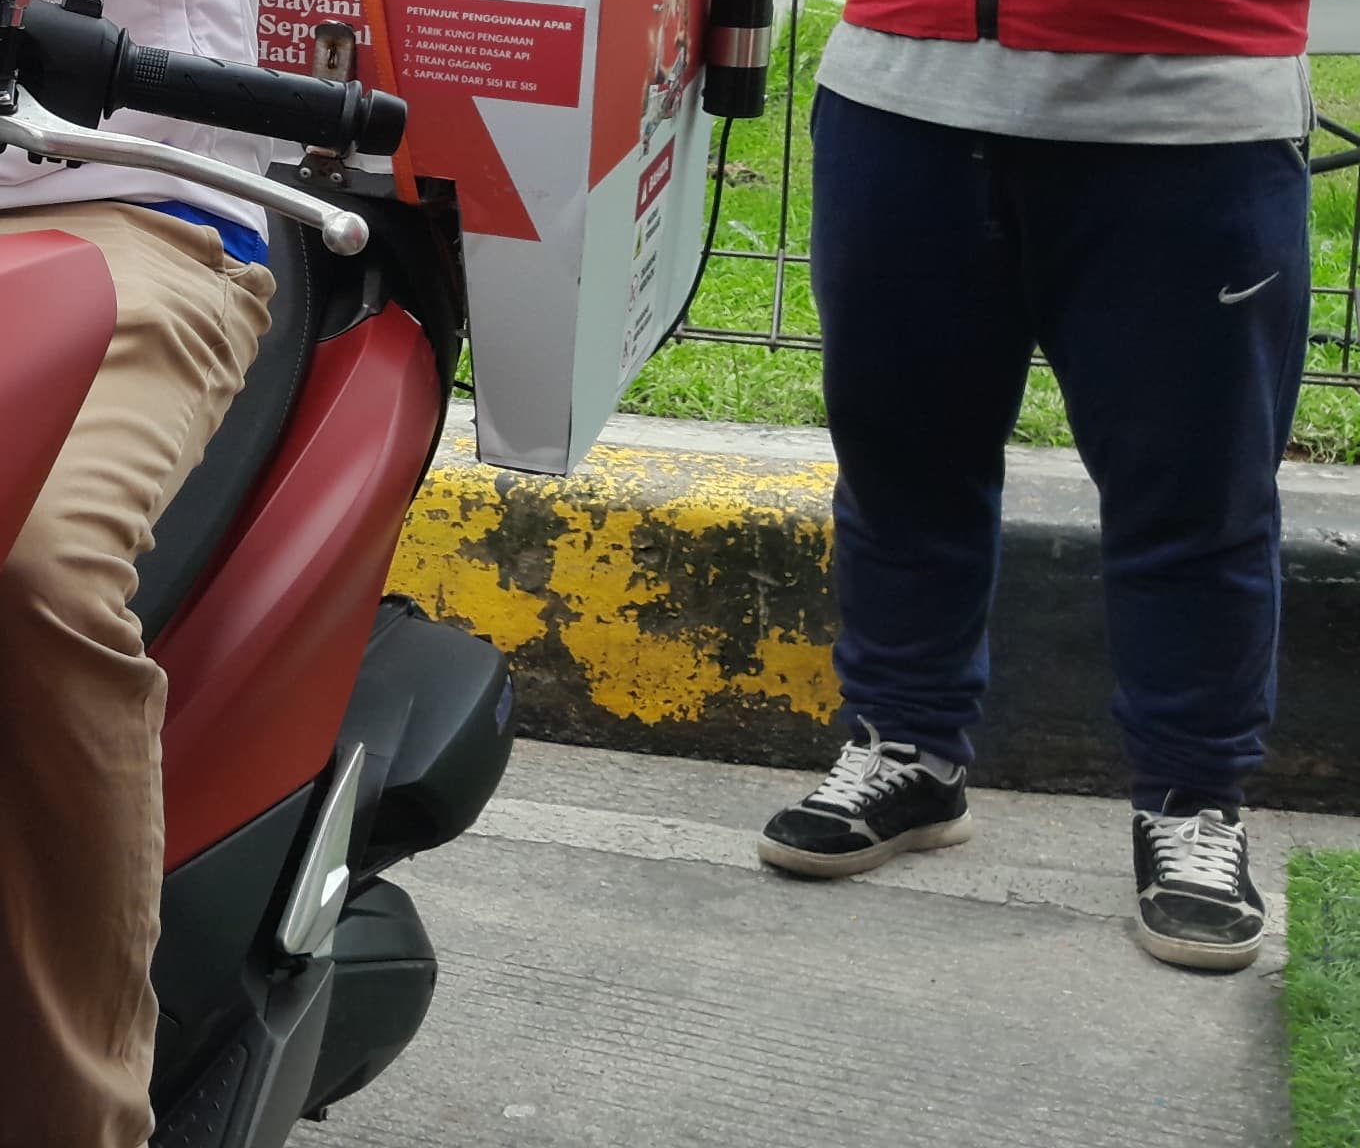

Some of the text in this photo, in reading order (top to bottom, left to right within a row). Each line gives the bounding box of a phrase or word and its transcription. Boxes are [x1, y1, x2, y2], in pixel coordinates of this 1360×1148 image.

[406, 5, 573, 31] PETUNJUK PENGGUNAAN APAR
[405, 25, 534, 46] 1. TARIK KUNCI PENGAMAN
[404, 39, 530, 60] 2. ARAHKAN KE DASAR API
[415, 54, 445, 67] TEKAN
[447, 58, 492, 71] GAGANG
[414, 70, 459, 82] SAPUKAN
[461, 75, 484, 85] DARI
[486, 78, 503, 88] SISI
[505, 80, 517, 89] KE
[520, 81, 537, 91] SISI
